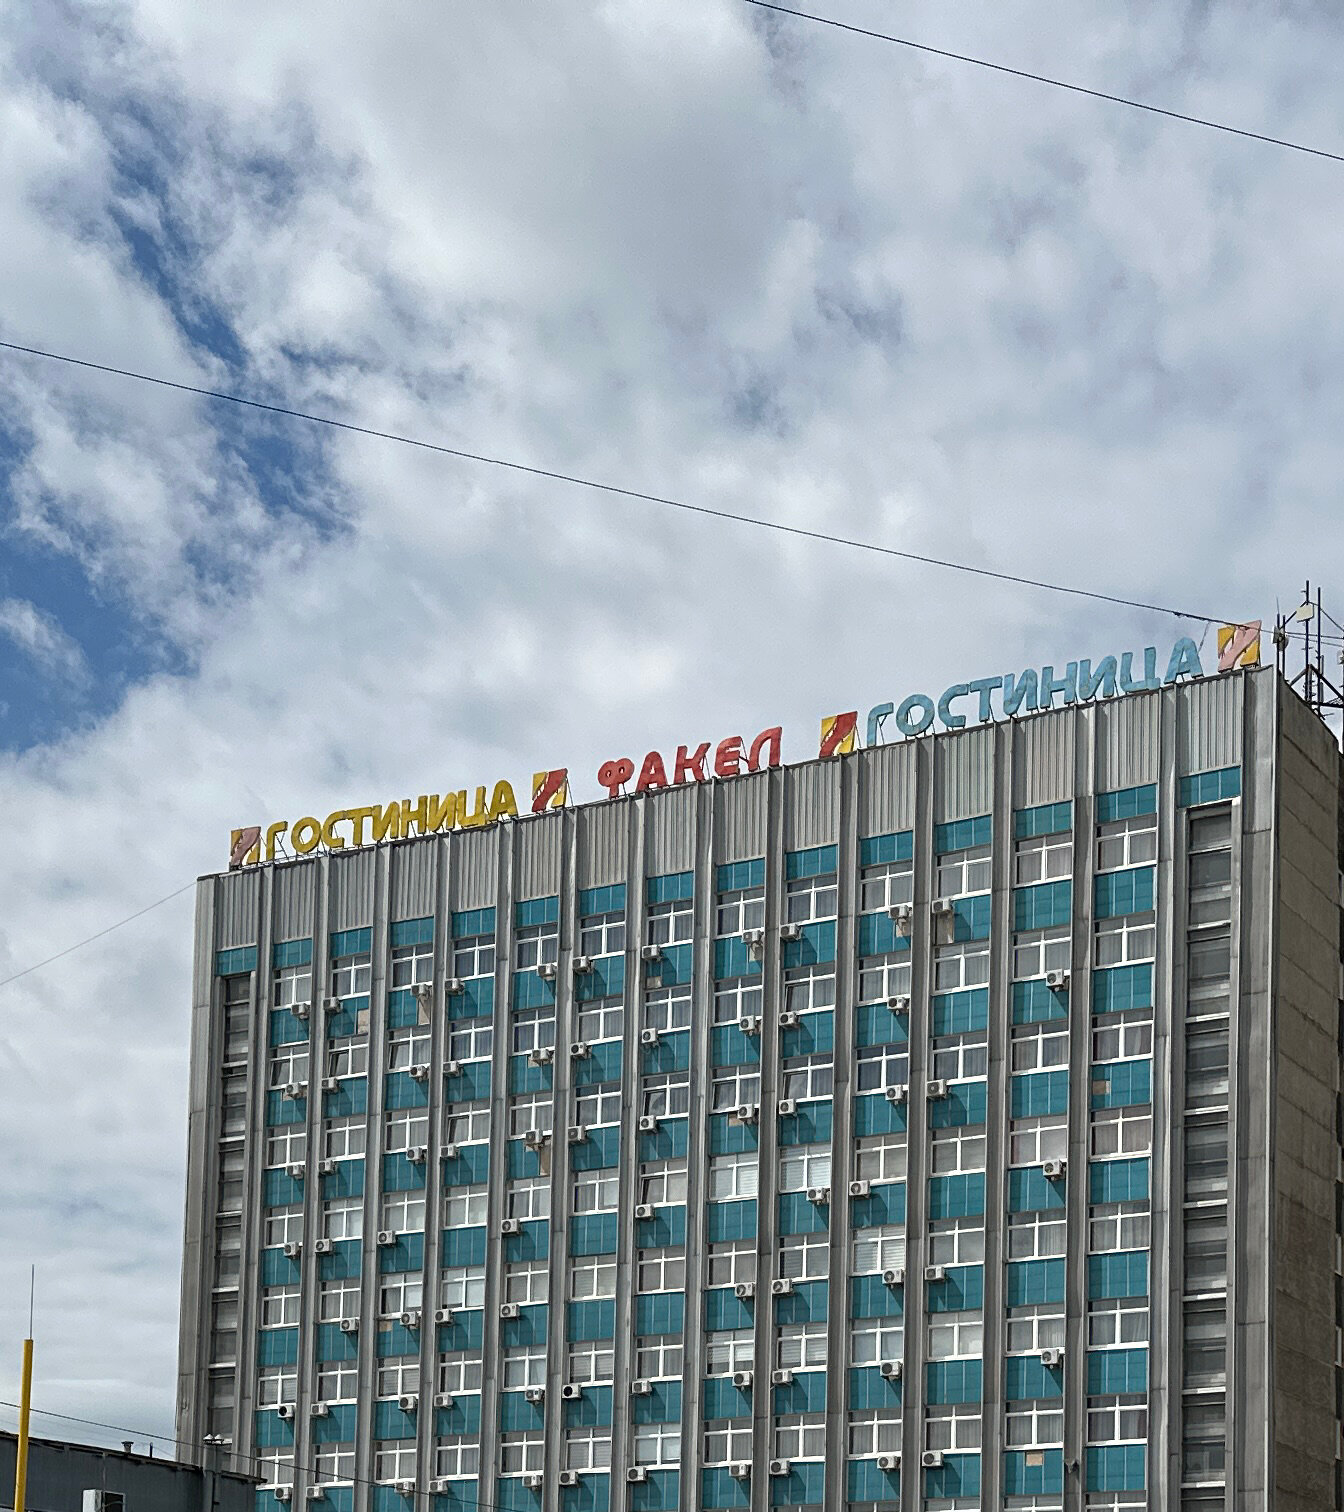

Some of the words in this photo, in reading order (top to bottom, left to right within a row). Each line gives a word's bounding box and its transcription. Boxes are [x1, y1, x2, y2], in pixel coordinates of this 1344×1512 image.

[265, 779, 519, 862] ГОСТИНИЦА
[597, 726, 783, 798] ФАКЕЛ
[866, 636, 1204, 747] ГОСТИНИЦА
